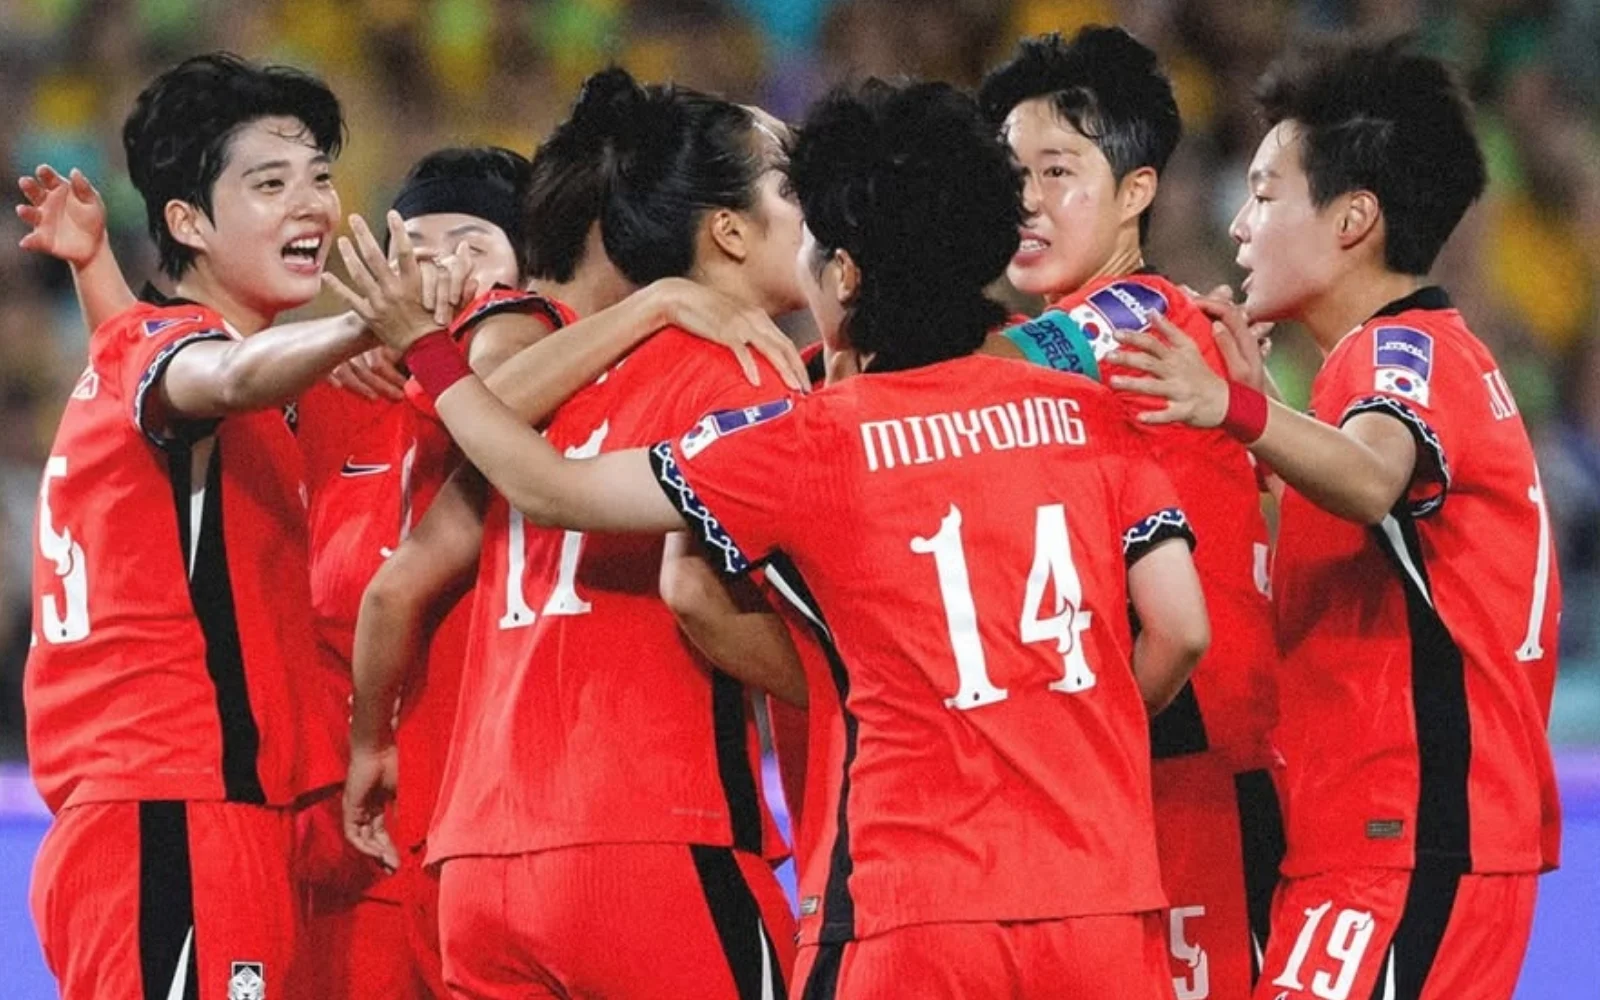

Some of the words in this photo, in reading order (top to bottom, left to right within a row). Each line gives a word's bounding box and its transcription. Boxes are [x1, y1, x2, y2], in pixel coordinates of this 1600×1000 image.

[860, 396, 1086, 472] MINYOUNG
[31, 456, 91, 644] 5
[910, 502, 1096, 710] 14
[1169, 905, 1210, 1000] 5
[1271, 899, 1375, 1000] 19
